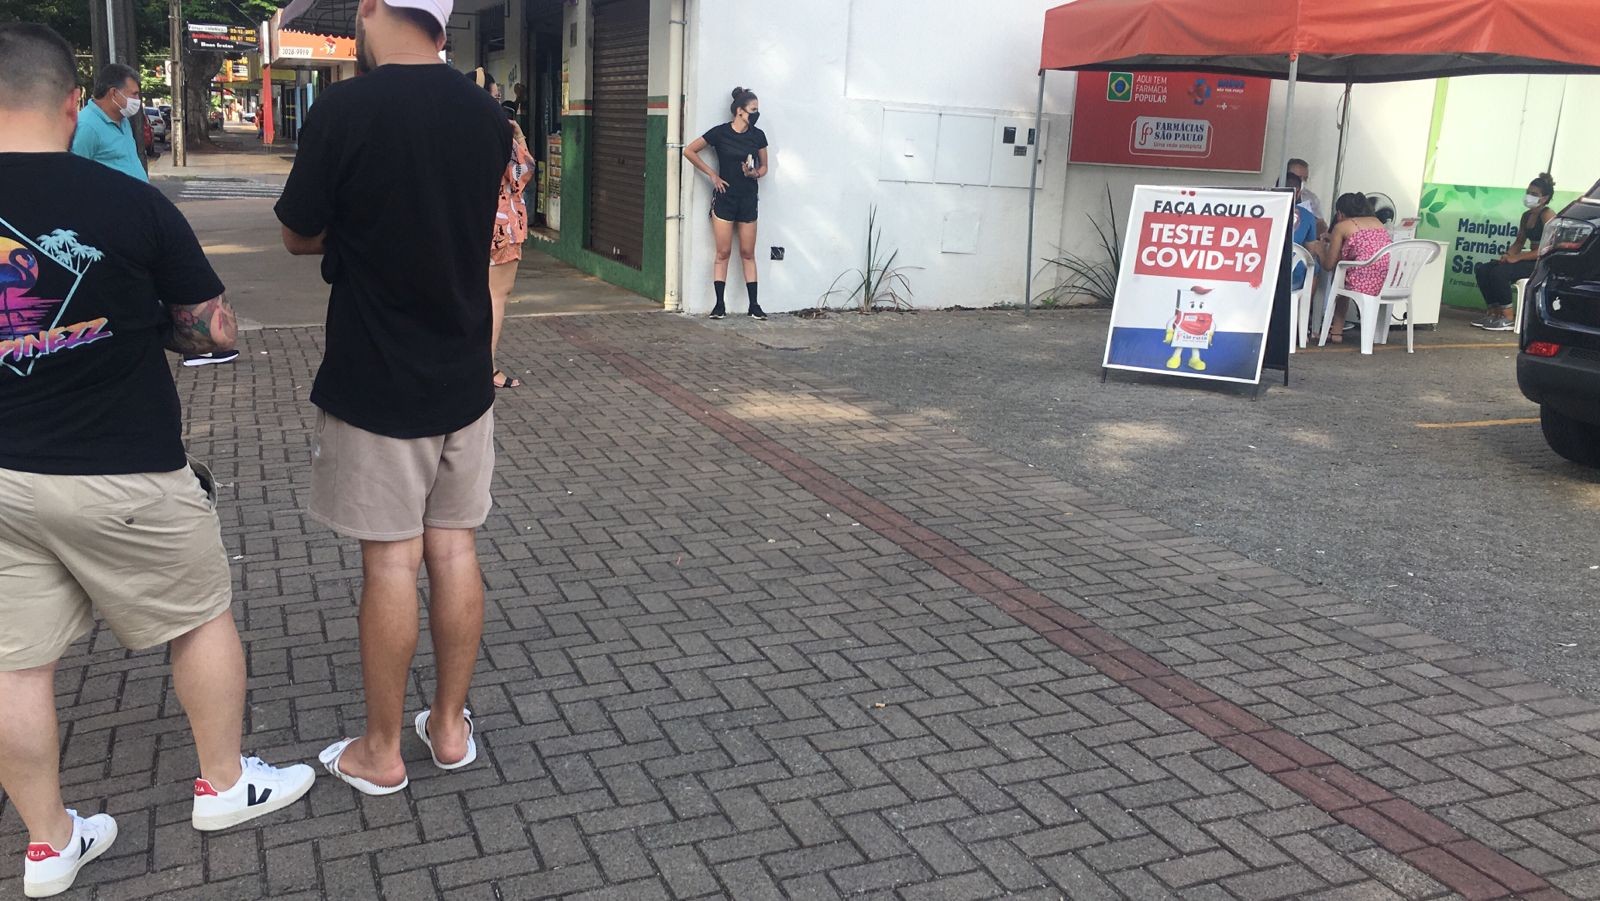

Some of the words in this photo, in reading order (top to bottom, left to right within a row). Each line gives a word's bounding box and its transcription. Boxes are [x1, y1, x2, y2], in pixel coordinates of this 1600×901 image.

[1136, 74, 1152, 84] AQUI
[1153, 75, 1168, 85] TEM
[1134, 93, 1167, 103] POPULAR
[1155, 121, 1205, 133] FARMÁCIAS
[1154, 131, 1172, 141] SÃO
[1174, 132, 1204, 142] PAULO
[1153, 200, 1196, 217] FAÇA
[1200, 203, 1247, 218] AQUI
[1249, 204, 1265, 218] O
[1150, 222, 1216, 247] TESTE
[1220, 227, 1259, 249] DA
[1141, 246, 1261, 273] COVID-19
